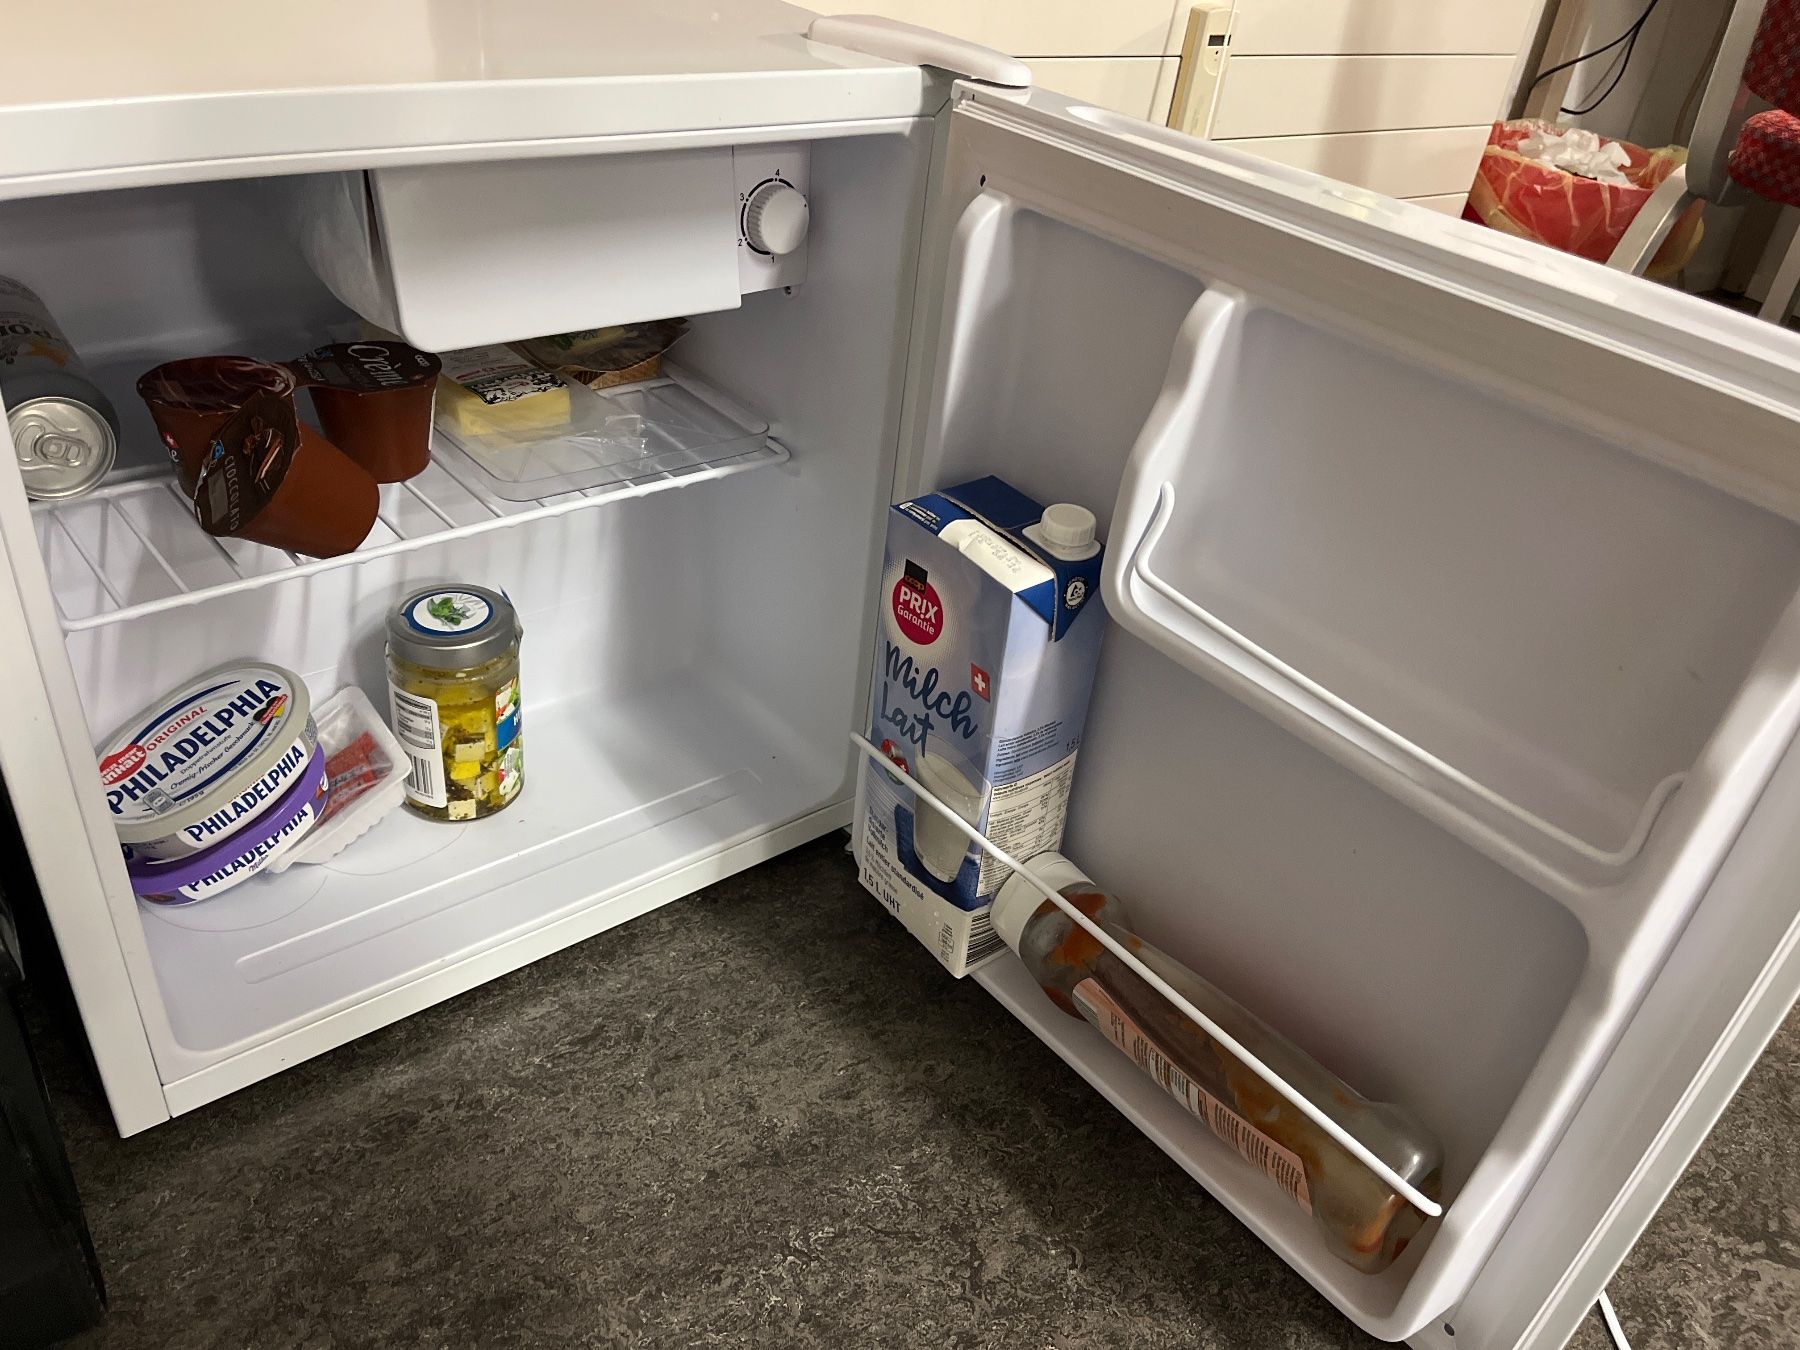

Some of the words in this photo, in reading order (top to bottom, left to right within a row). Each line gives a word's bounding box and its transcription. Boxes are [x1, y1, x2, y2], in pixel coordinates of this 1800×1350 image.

[897, 606, 935, 636] Garantie
[146, 706, 208, 752] ORIGINAL
[880, 681, 935, 758] Lait
[885, 640, 979, 740] Milch
[106, 679, 282, 815] PHILADELPHIA
[183, 744, 305, 842] PHILADELPHIA
[187, 808, 309, 892] PHILADELPHIA
[883, 890, 901, 913] UHT
